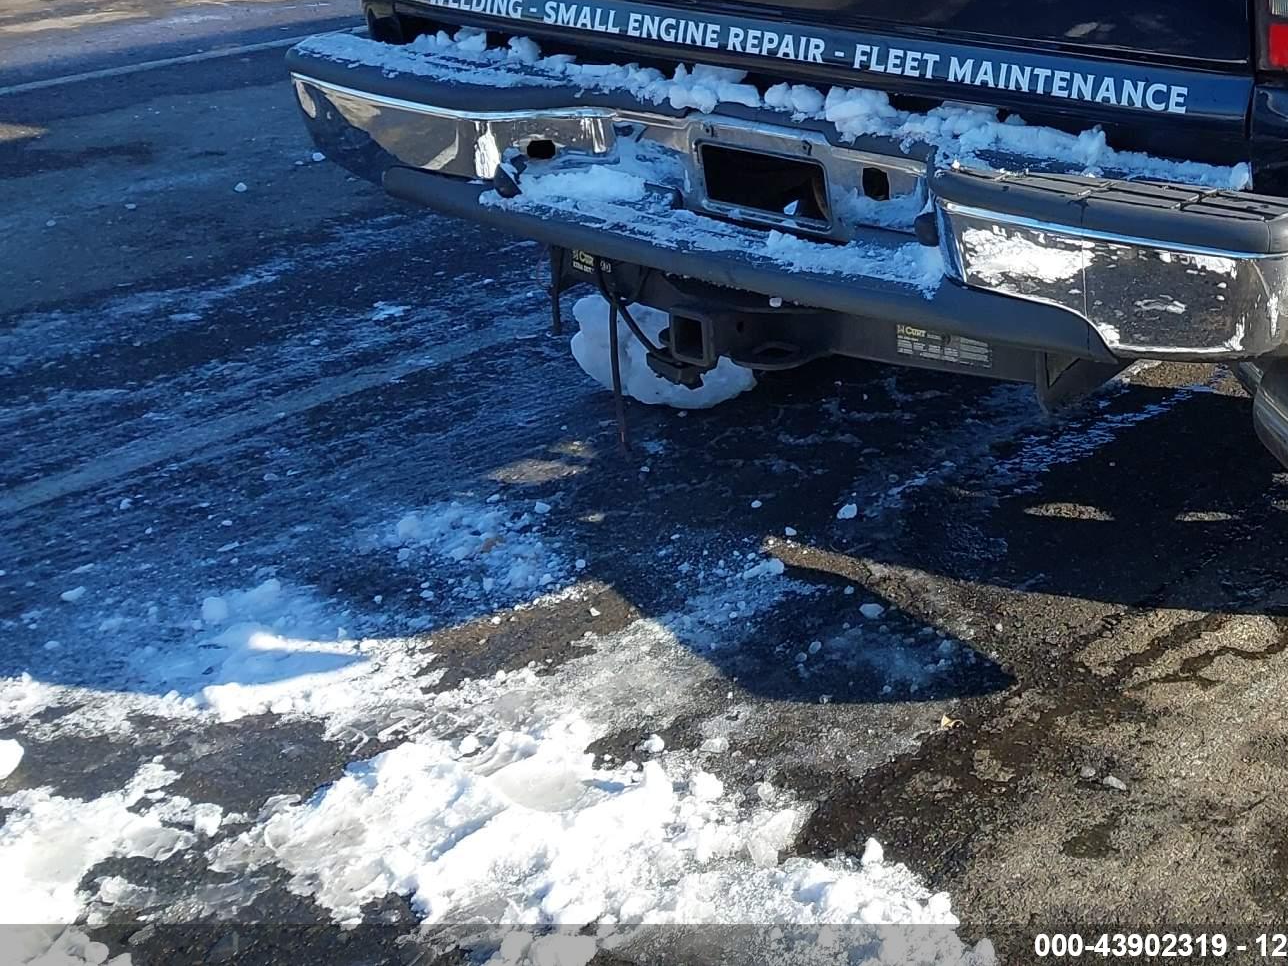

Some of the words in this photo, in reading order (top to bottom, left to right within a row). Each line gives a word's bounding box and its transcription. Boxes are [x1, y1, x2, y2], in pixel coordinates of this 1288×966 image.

[544, 2, 620, 34] SMALL
[628, 14, 721, 49] ENGINE
[728, 27, 825, 64] REPAIR
[853, 44, 940, 79] FLEET
[948, 56, 1188, 114] MAINTENANCE
